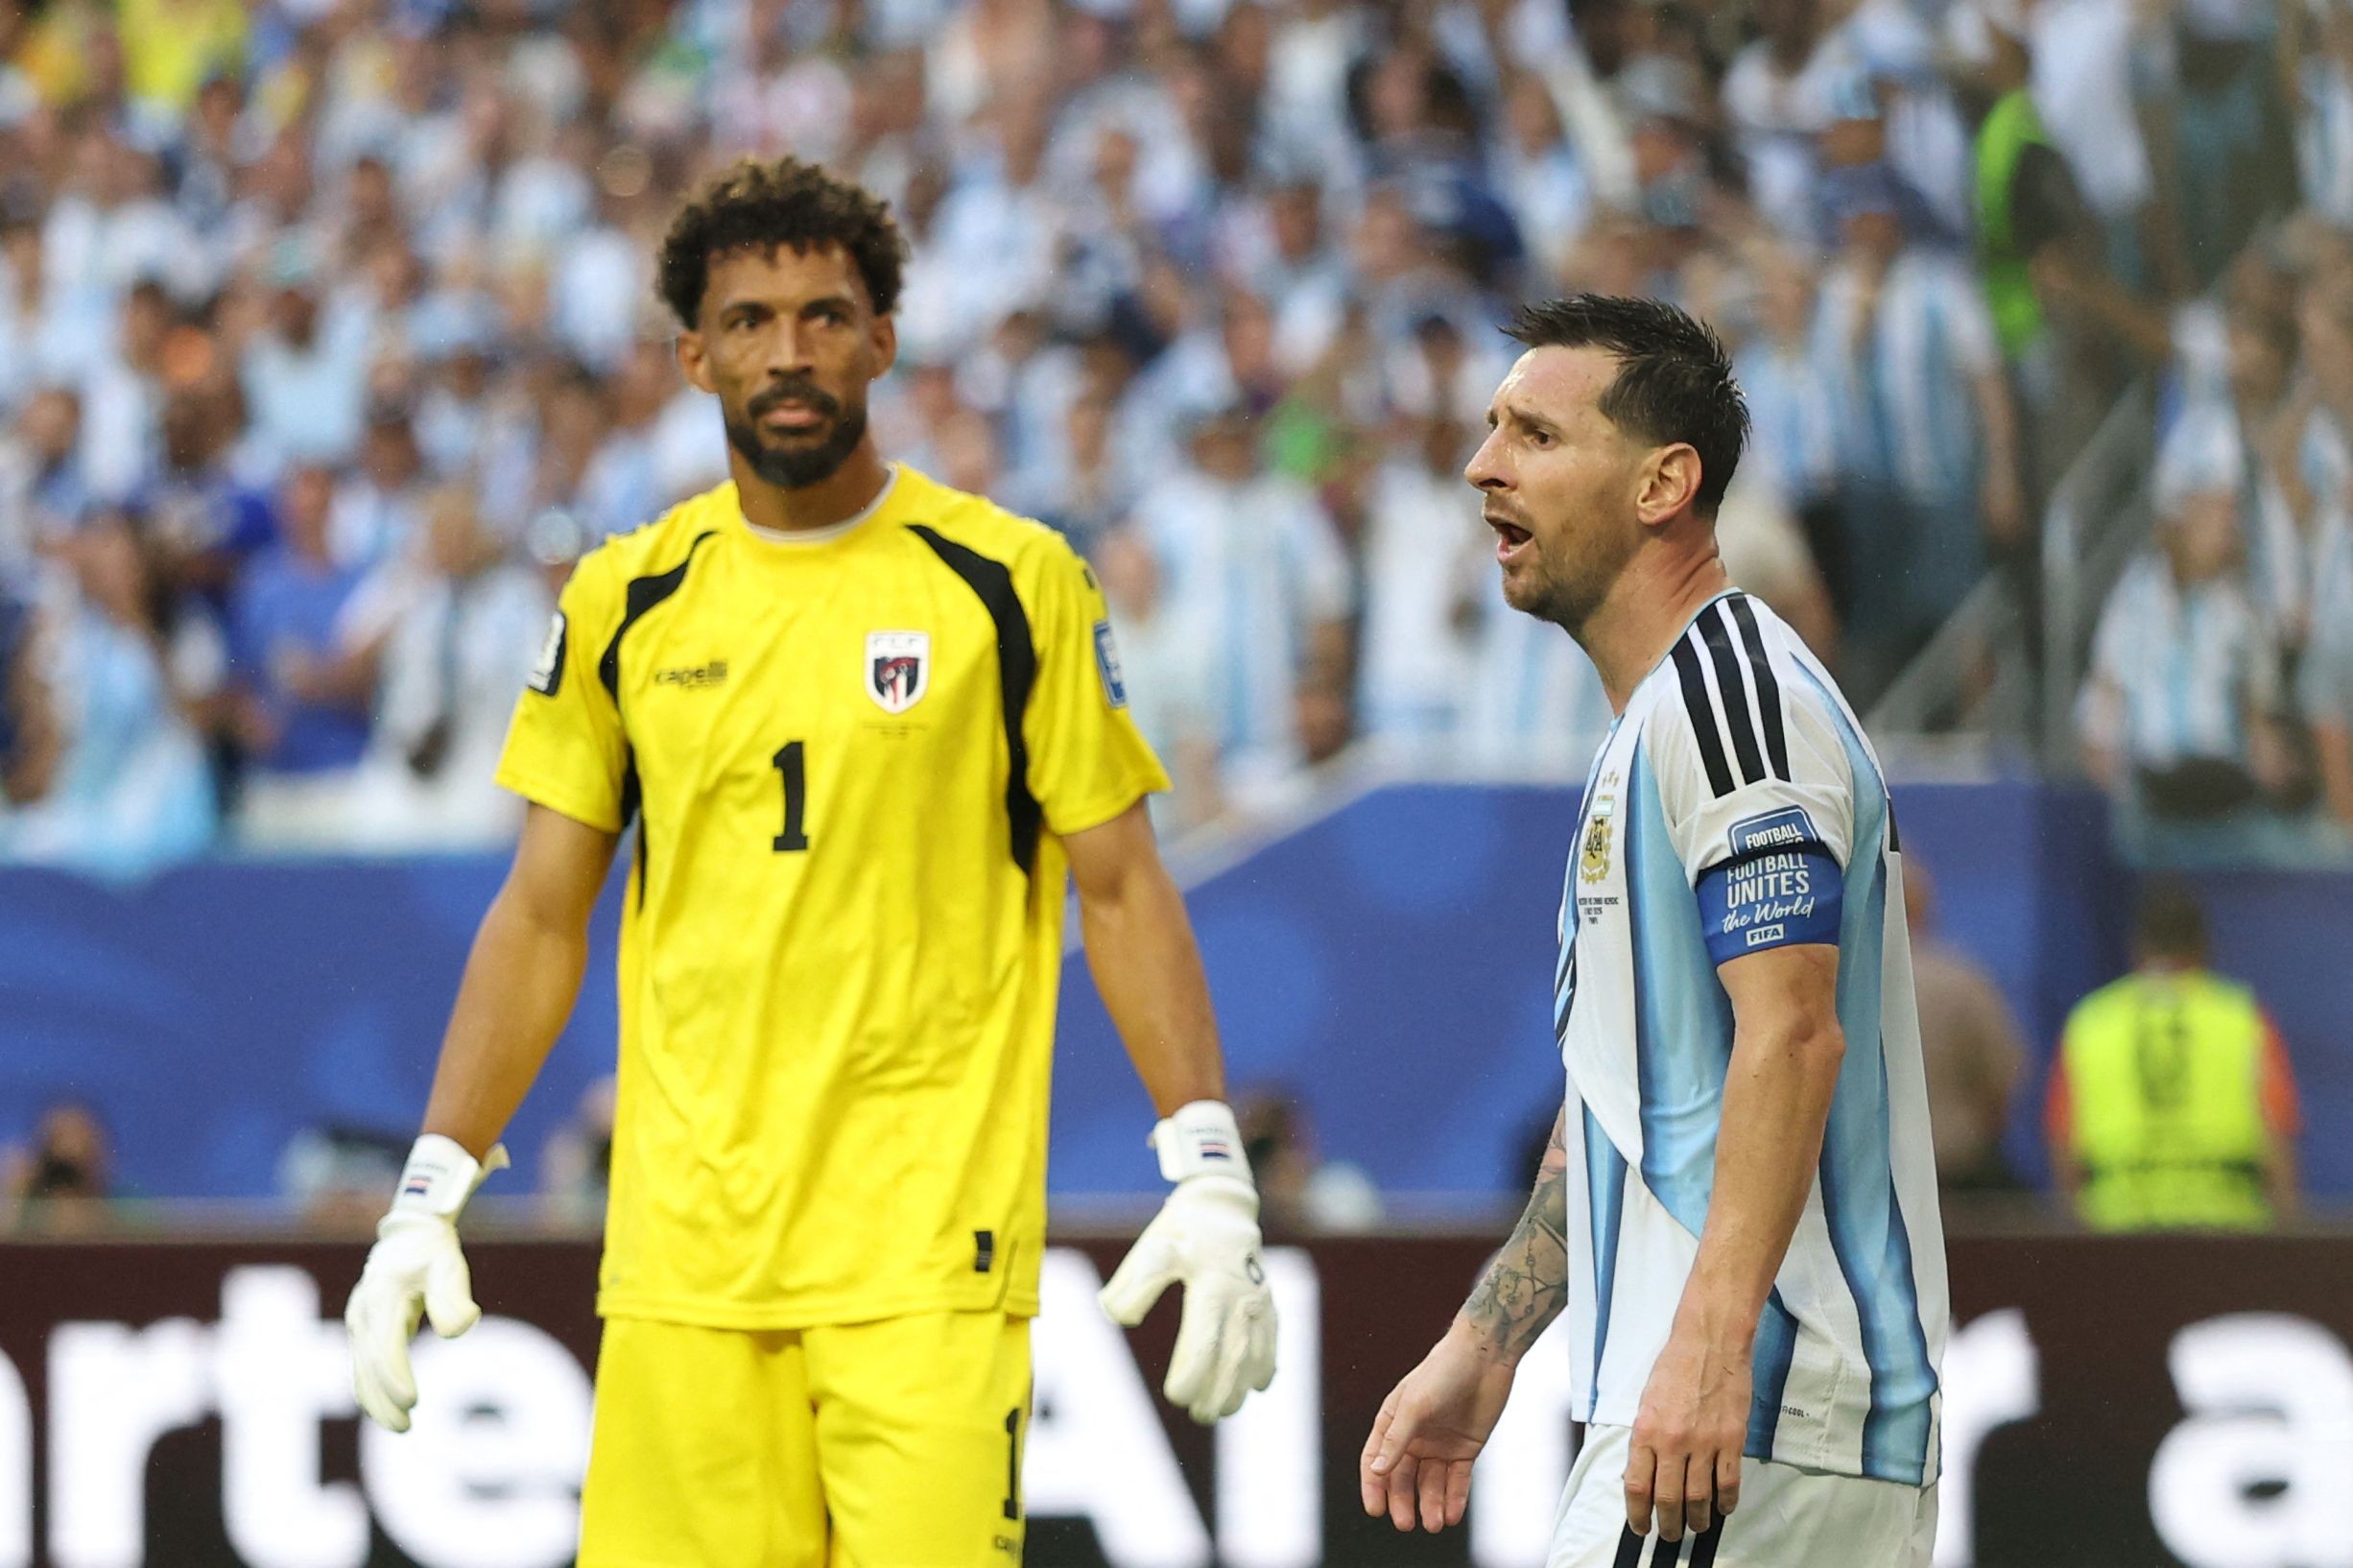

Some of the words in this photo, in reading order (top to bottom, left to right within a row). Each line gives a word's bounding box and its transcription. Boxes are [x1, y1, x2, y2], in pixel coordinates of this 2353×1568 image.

[772, 740, 808, 852] 1
[1745, 822, 1802, 849] FOOTBALL
[1727, 852, 1808, 884] FOOTBALL
[1727, 870, 1810, 910] UNITES
[1722, 909, 1751, 935] the
[1753, 895, 1816, 924] World
[1748, 927, 1782, 943] FIFA
[0, 1262, 600, 1568] rte
